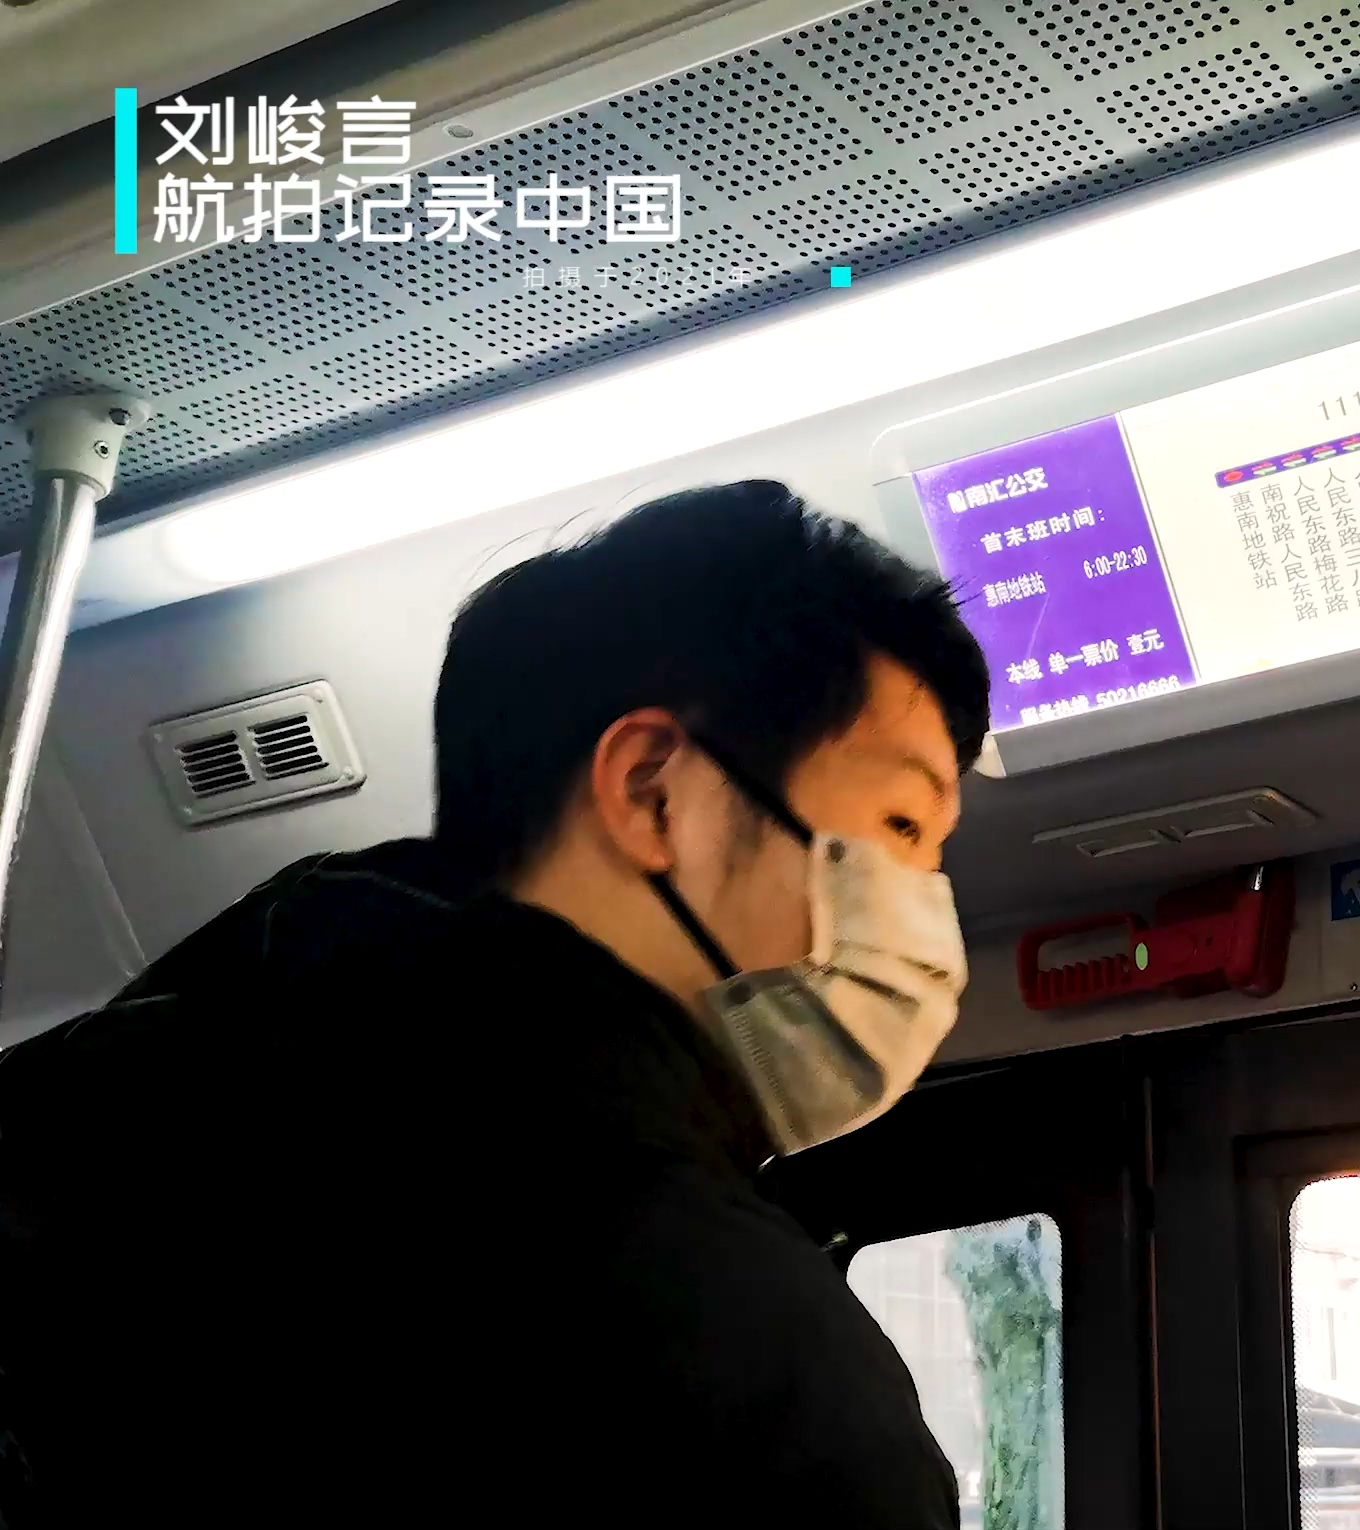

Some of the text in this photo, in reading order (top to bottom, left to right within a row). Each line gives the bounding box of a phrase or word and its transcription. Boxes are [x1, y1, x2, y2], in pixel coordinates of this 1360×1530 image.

[982, 545, 1148, 608] 惠南地铁站 6:00-22:30
[1231, 491, 1279, 589] 惠南地铁站
[1260, 482, 1318, 622] 南祝路人民东路
[1294, 475, 1348, 614] 人民东路梅花路
[1006, 628, 1164, 684] 本线 单一票价 壹元
